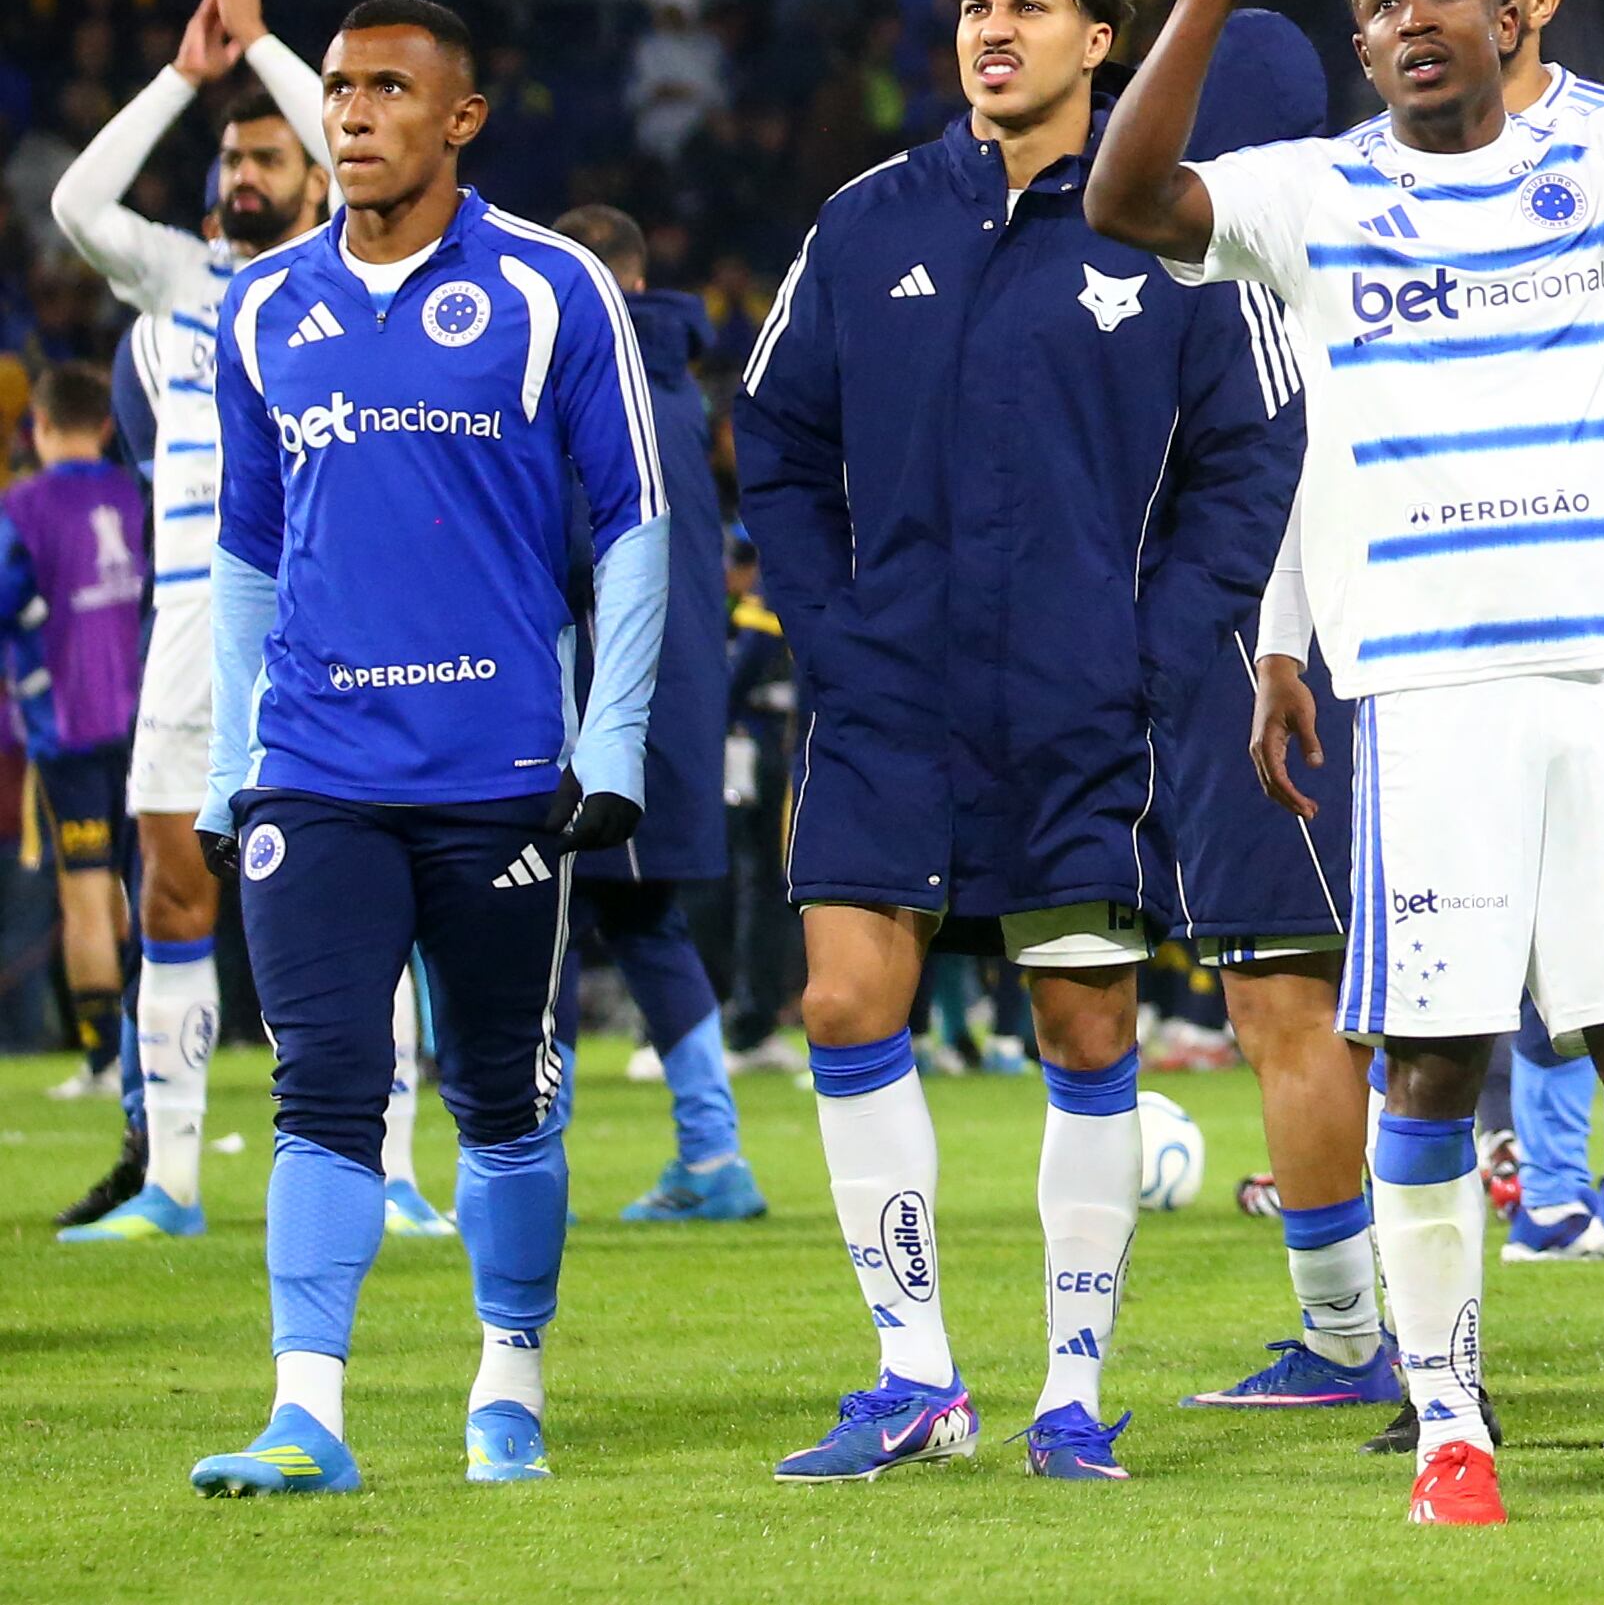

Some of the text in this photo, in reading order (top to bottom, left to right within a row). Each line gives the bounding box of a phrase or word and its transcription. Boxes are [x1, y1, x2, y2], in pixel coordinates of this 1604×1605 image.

[1440, 488, 1590, 525] PERDIGÃO
[354, 655, 497, 688] PERDIGÃO
[893, 1200, 931, 1288] Kodilar
[1056, 1271, 1115, 1295] CEC
